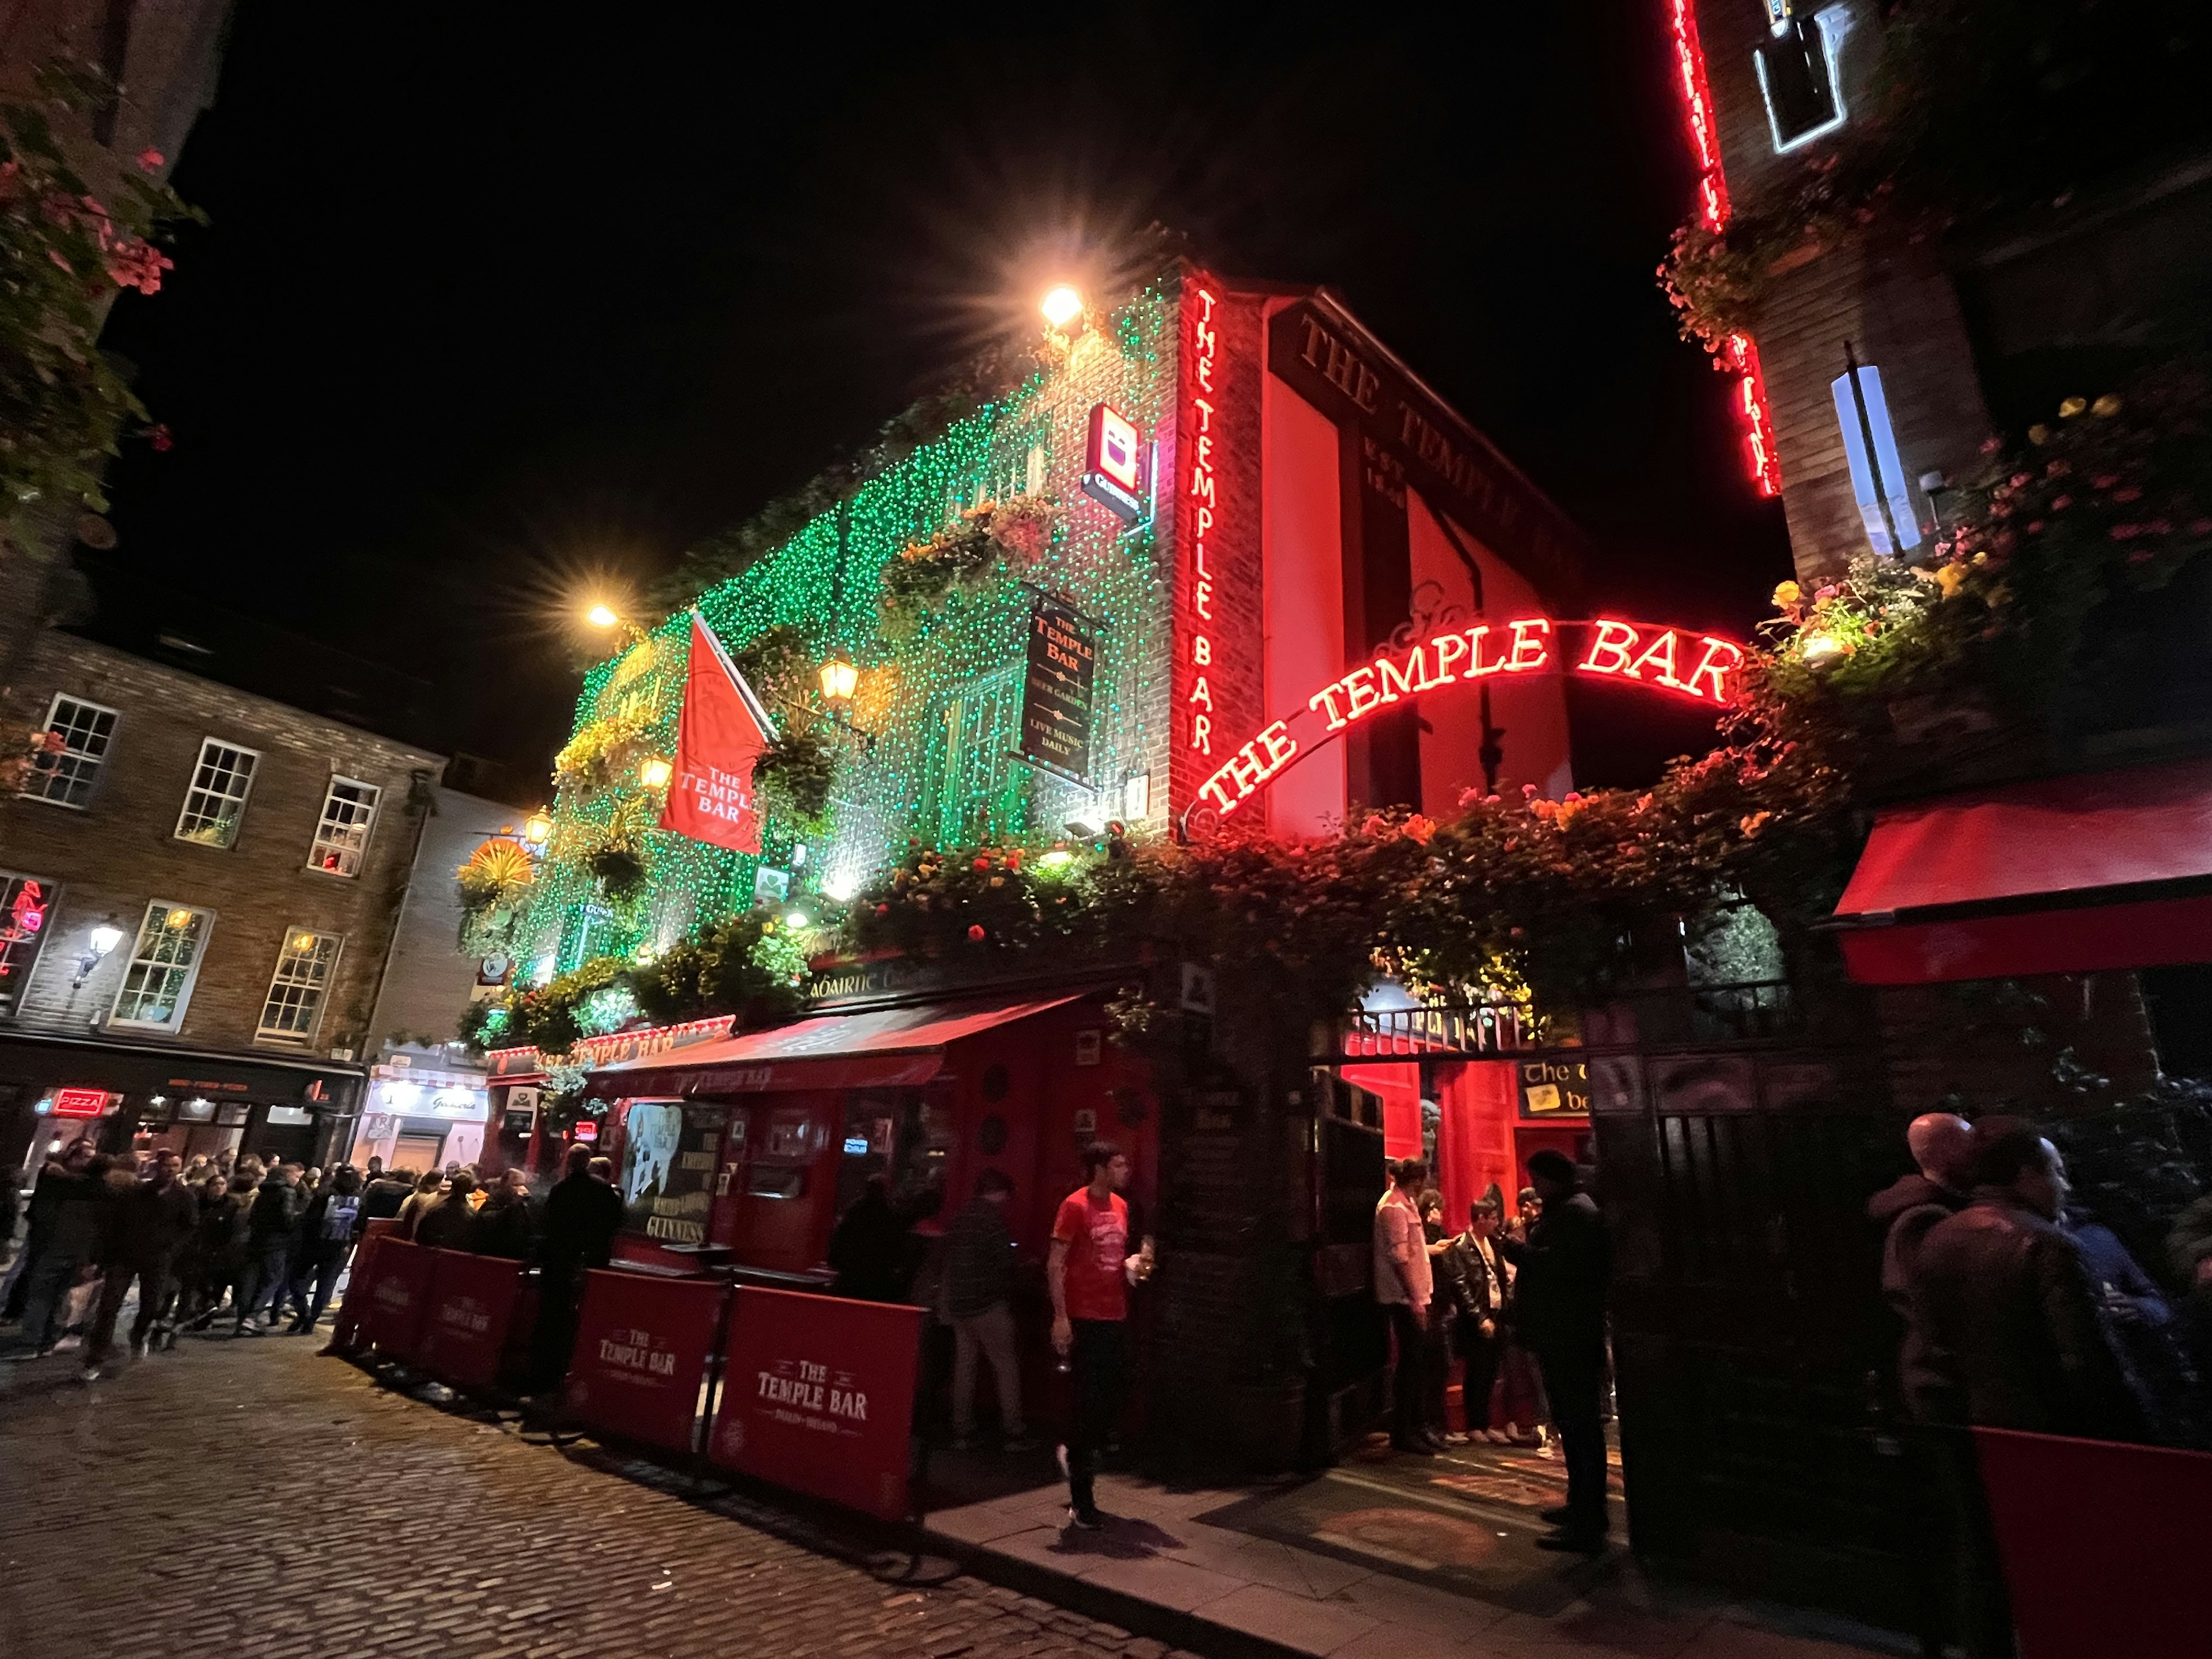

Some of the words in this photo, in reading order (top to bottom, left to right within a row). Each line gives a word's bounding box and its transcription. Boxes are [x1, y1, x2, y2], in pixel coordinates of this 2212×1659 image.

[1196, 289, 1217, 393] THE
[1300, 313, 1380, 415] THE
[1190, 399, 1215, 620] TEMPLE
[1035, 615, 1093, 660] TEMPLE
[1056, 616, 1075, 634] THE
[1047, 642, 1079, 672] BAR
[1189, 635, 1213, 755] BAR
[1199, 720, 1298, 815] THE
[1309, 618, 1551, 732] TEMPLE
[1579, 619, 1745, 703] BAR
[1031, 718, 1052, 736] LIVE
[1054, 729, 1083, 748] MUSIC
[1041, 737, 1070, 755] DAILY
[680, 772, 749, 810] TEMPL
[709, 767, 741, 789] THE
[698, 796, 739, 823] BAR
[570, 1042, 631, 1067] TEMPLE
[637, 1037, 675, 1059] BAR
[1523, 1062, 1570, 1082] The
[60, 1096, 98, 1107] PIZZA
[630, 1329, 649, 1347] THE
[600, 1339, 646, 1369] TEMPLE
[800, 1360, 827, 1383] THE
[758, 1372, 824, 1410] TEMPLE
[829, 1389, 866, 1421] BAR
